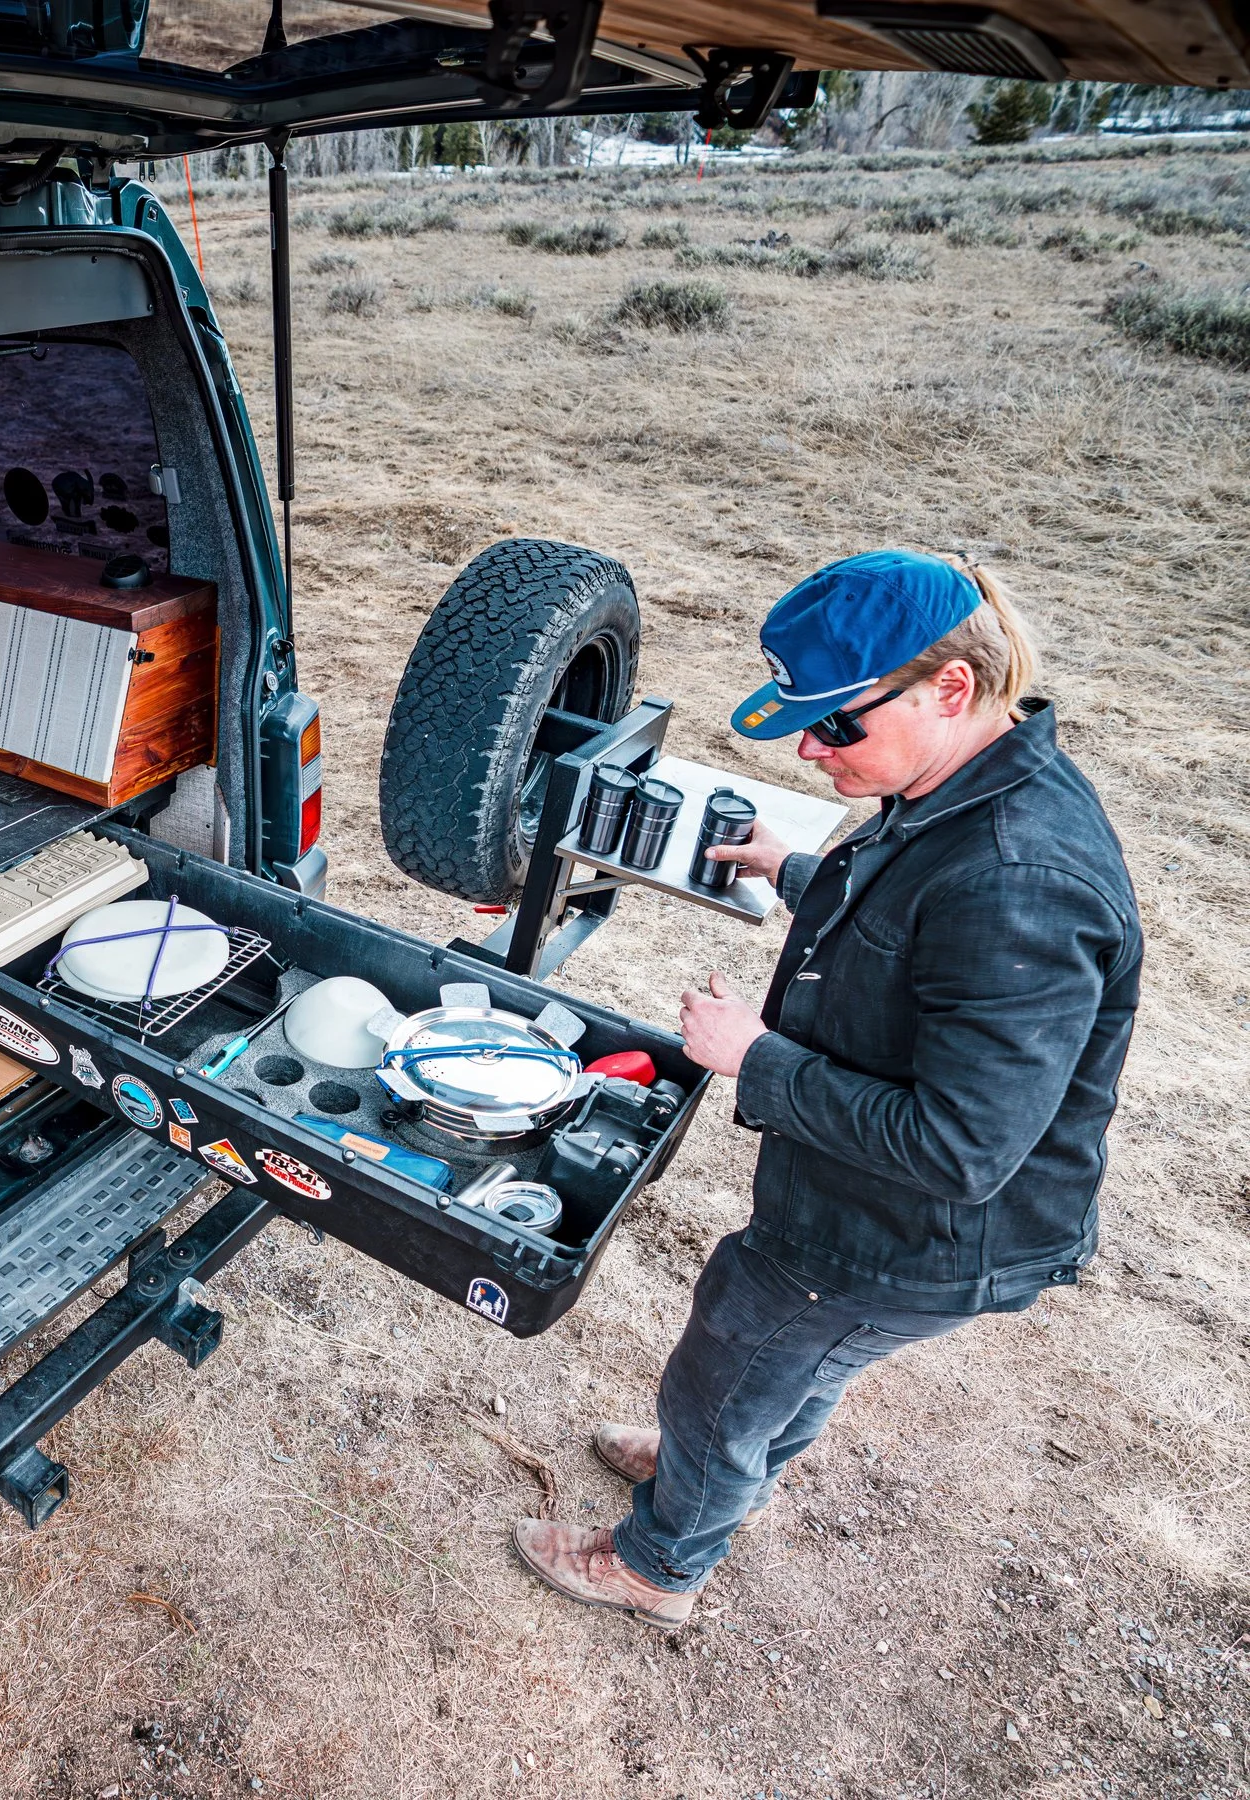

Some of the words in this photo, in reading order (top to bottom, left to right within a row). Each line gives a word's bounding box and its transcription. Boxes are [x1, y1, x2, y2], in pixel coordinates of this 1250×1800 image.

[78, 1064, 93, 1074] YETI
[264, 1163, 289, 1181] RACING
[287, 1173, 321, 1198] PRODUCTS
[270, 1155, 315, 1183] B&M
